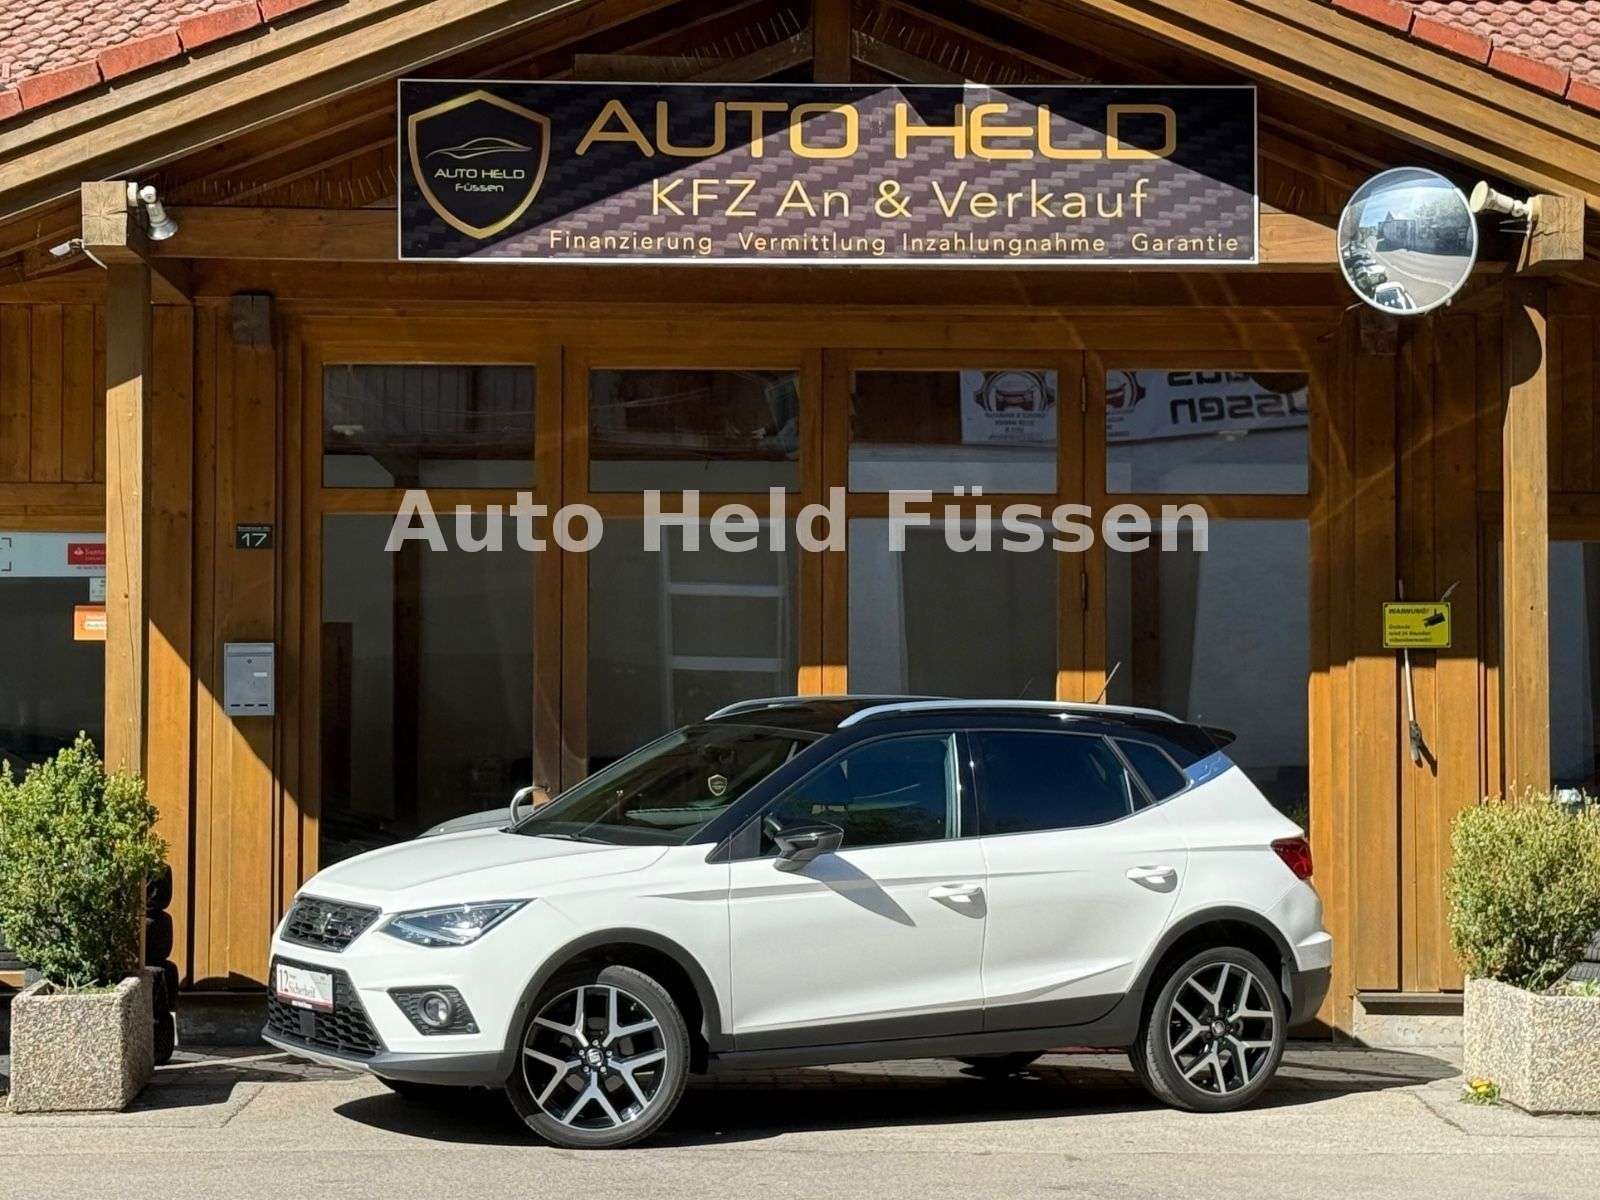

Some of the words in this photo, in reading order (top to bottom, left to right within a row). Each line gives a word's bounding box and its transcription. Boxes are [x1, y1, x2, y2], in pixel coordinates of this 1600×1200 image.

[575, 99, 859, 159] AUTO
[895, 102, 1177, 160] HELD
[434, 168, 477, 179] AUTO
[481, 169, 525, 180] HELD
[454, 182, 505, 193] Füssen
[652, 178, 757, 217] KFZ
[776, 179, 850, 218] An
[873, 179, 913, 219] &
[931, 178, 1150, 219] Verkauf
[549, 230, 713, 255] Finanzierung
[738, 231, 887, 255] Vermittlung
[903, 232, 1106, 256] Inzahlungnahme
[1131, 231, 1239, 253] Garantie
[241, 532, 268, 548] 17
